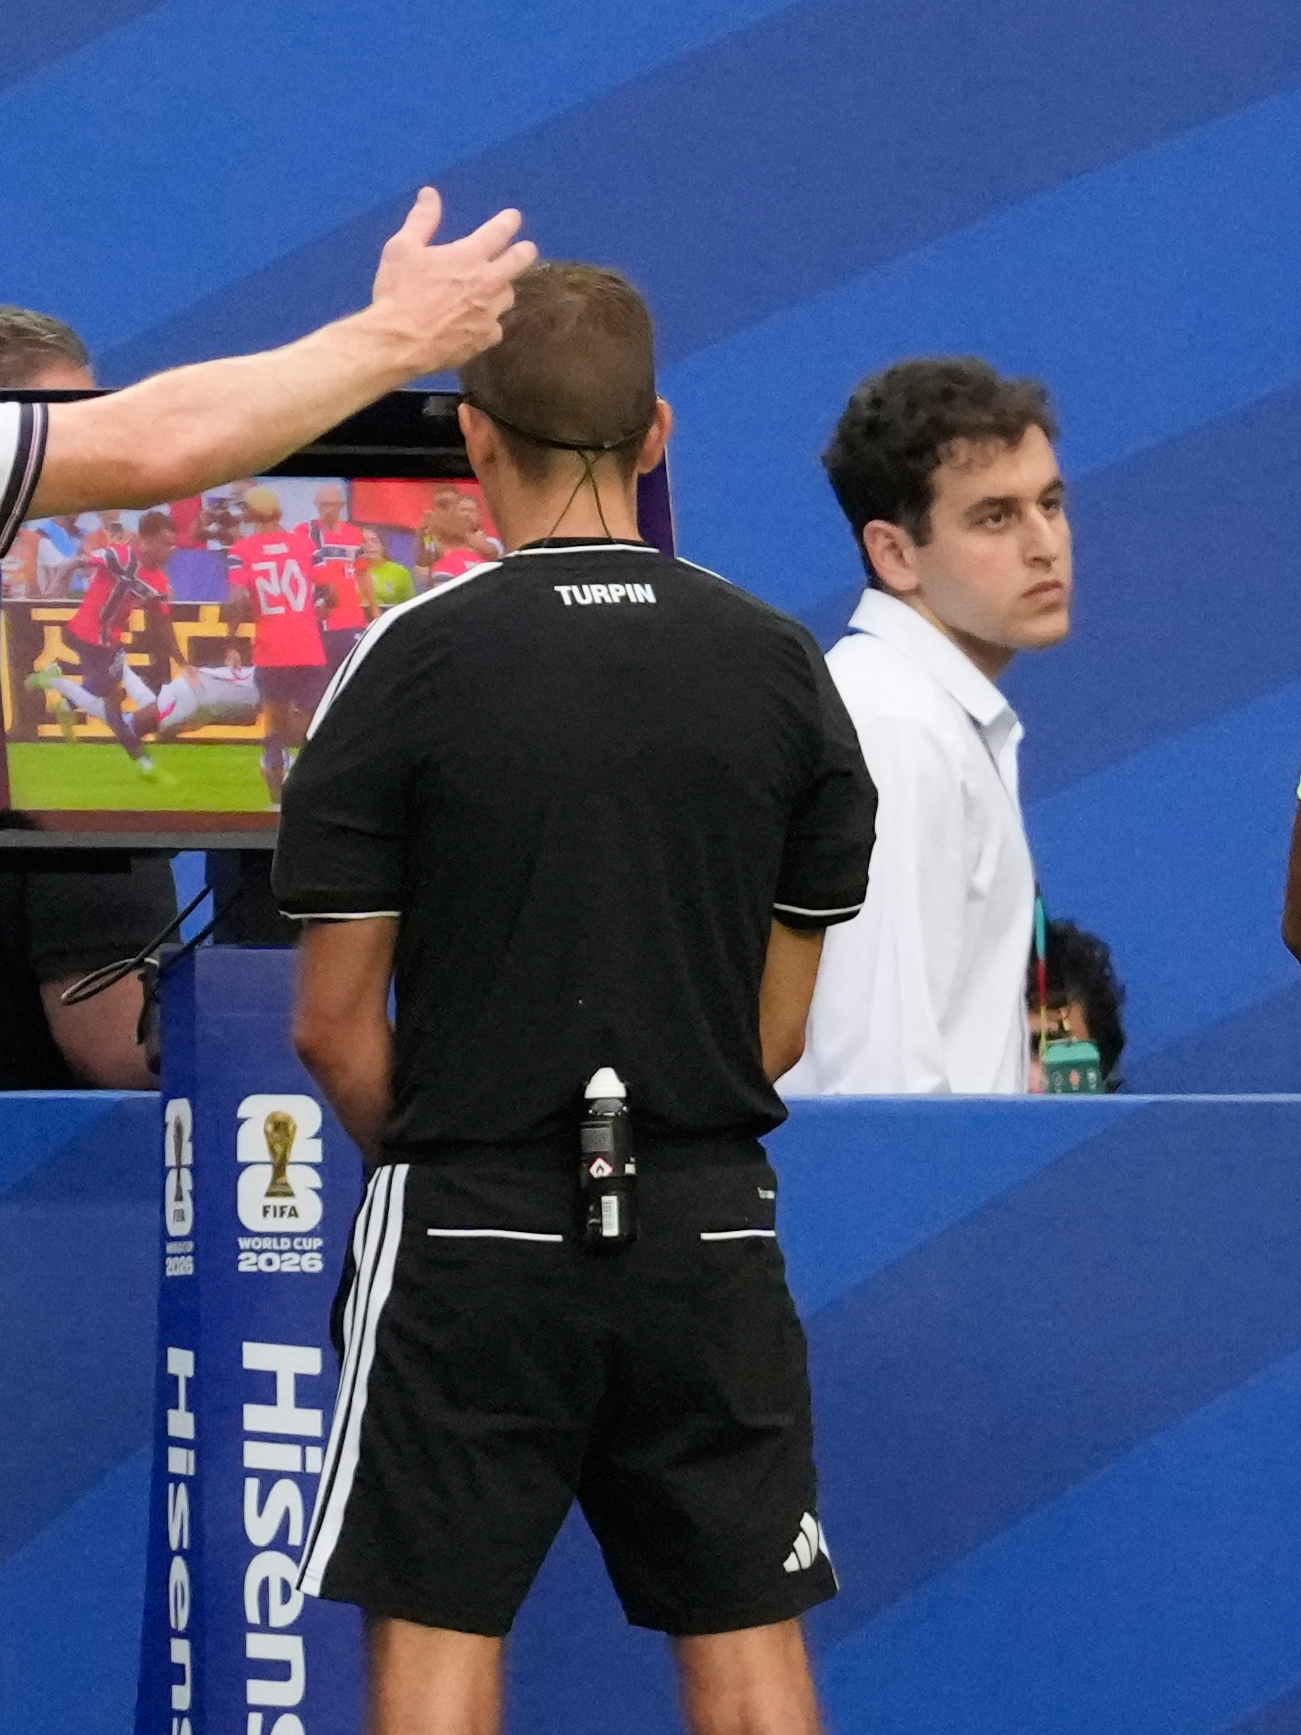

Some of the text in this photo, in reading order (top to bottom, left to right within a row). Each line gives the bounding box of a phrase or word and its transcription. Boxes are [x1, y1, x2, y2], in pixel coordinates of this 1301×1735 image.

[251, 559, 307, 615] 20
[554, 583, 657, 606] TURPIN
[262, 1204, 299, 1219] FIFA
[237, 1237, 324, 1251] WORLD CUP
[237, 1252, 324, 1273] 2026
[166, 1347, 196, 1735] Hisen
